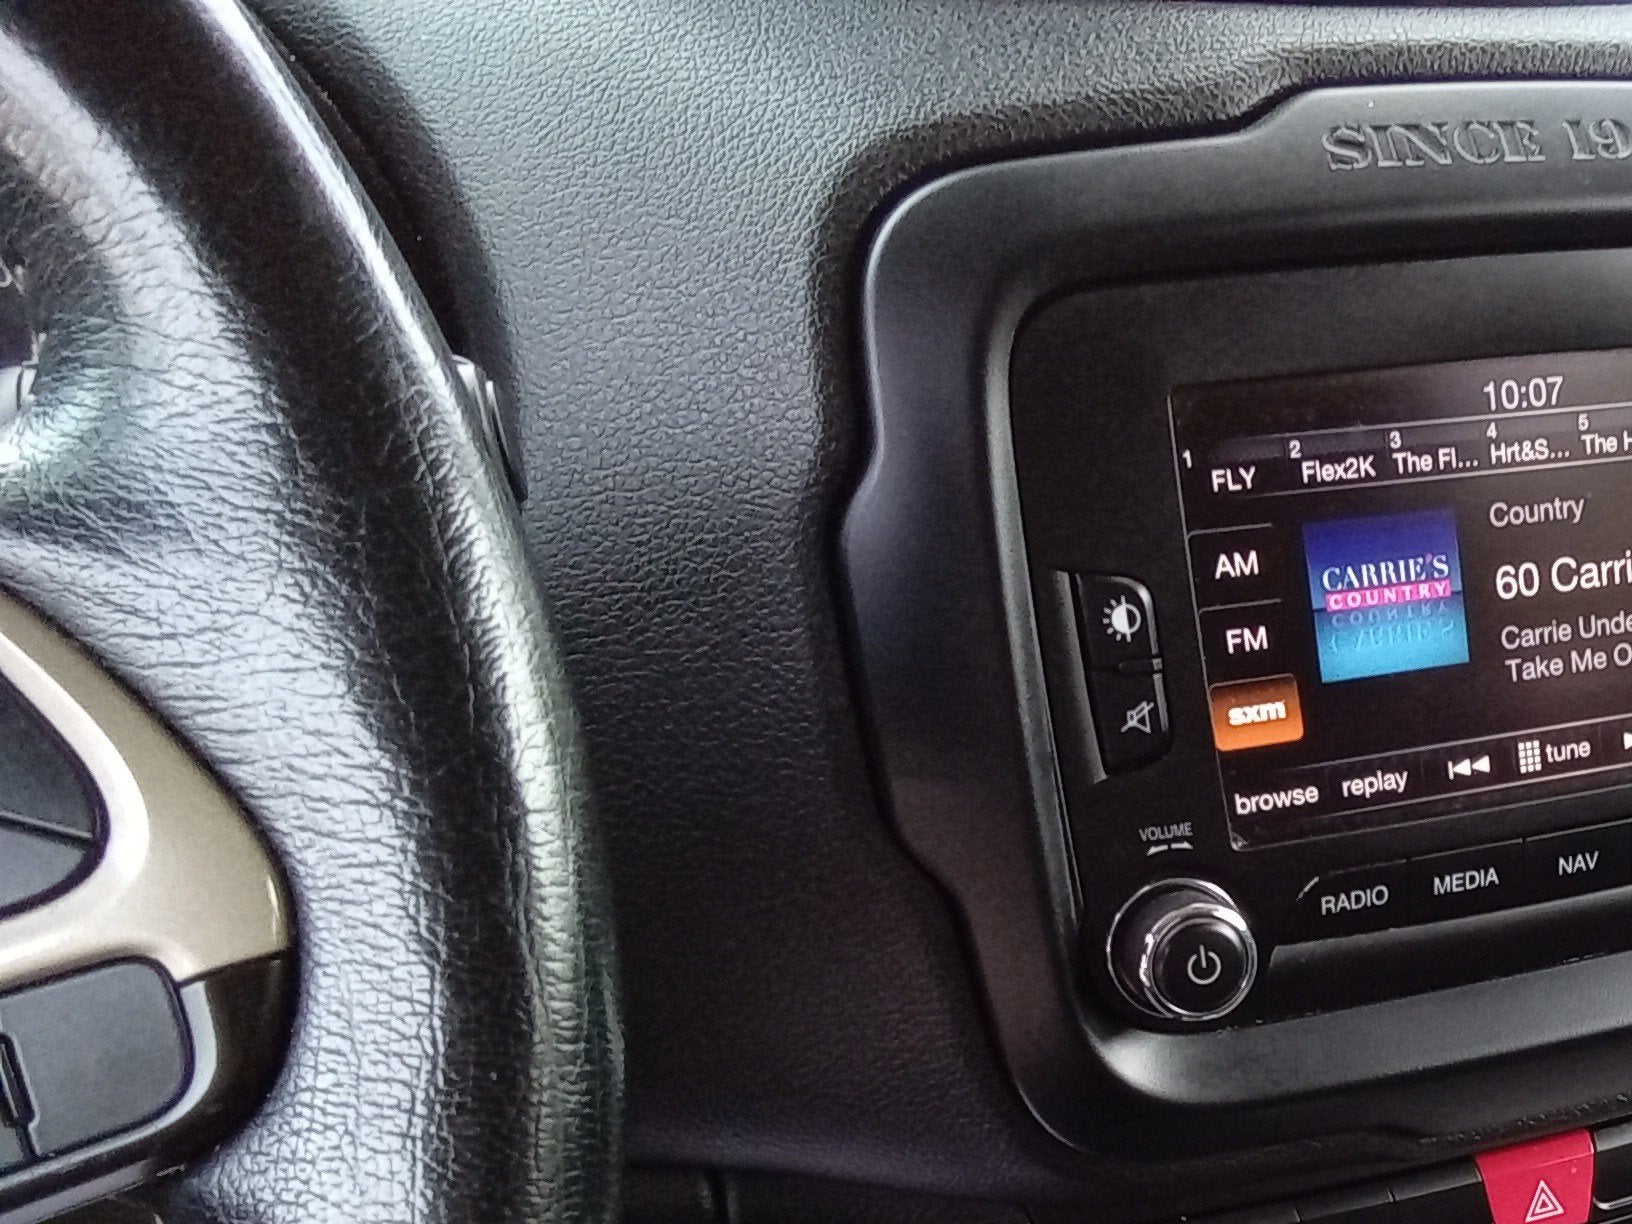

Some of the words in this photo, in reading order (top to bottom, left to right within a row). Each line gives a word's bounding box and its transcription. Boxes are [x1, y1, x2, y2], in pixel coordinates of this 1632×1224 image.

[1321, 118, 1546, 171] SINCE
[1483, 375, 1563, 412] 10:07
[1486, 421, 1497, 439] 4
[1578, 413, 1589, 431] 5
[1289, 439, 1302, 459] 2
[1389, 430, 1401, 449] 3
[1581, 432, 1617, 456] The
[1183, 449, 1192, 468] 1
[1301, 455, 1376, 484] Flex2K
[1393, 449, 1432, 475] The
[1211, 465, 1256, 493] FLY
[1489, 496, 1585, 528] Country
[1215, 550, 1259, 580] AM
[1322, 553, 1449, 592] CARRIE'S
[1495, 562, 1540, 600] 60
[1328, 582, 1449, 611] COUNTRY
[1226, 625, 1268, 654] FM
[1501, 620, 1572, 651] Carrie
[1505, 654, 1564, 683] Take
[1571, 647, 1607, 674] Me
[1228, 700, 1287, 726] sxm
[1545, 740, 1592, 764] tune
[1342, 769, 1409, 799] replay
[1234, 785, 1320, 815] browse
[1138, 821, 1193, 842] VOLUME
[1558, 851, 1599, 876] NAV
[1433, 867, 1500, 896] MEDIA
[1321, 884, 1389, 916] RADIO
